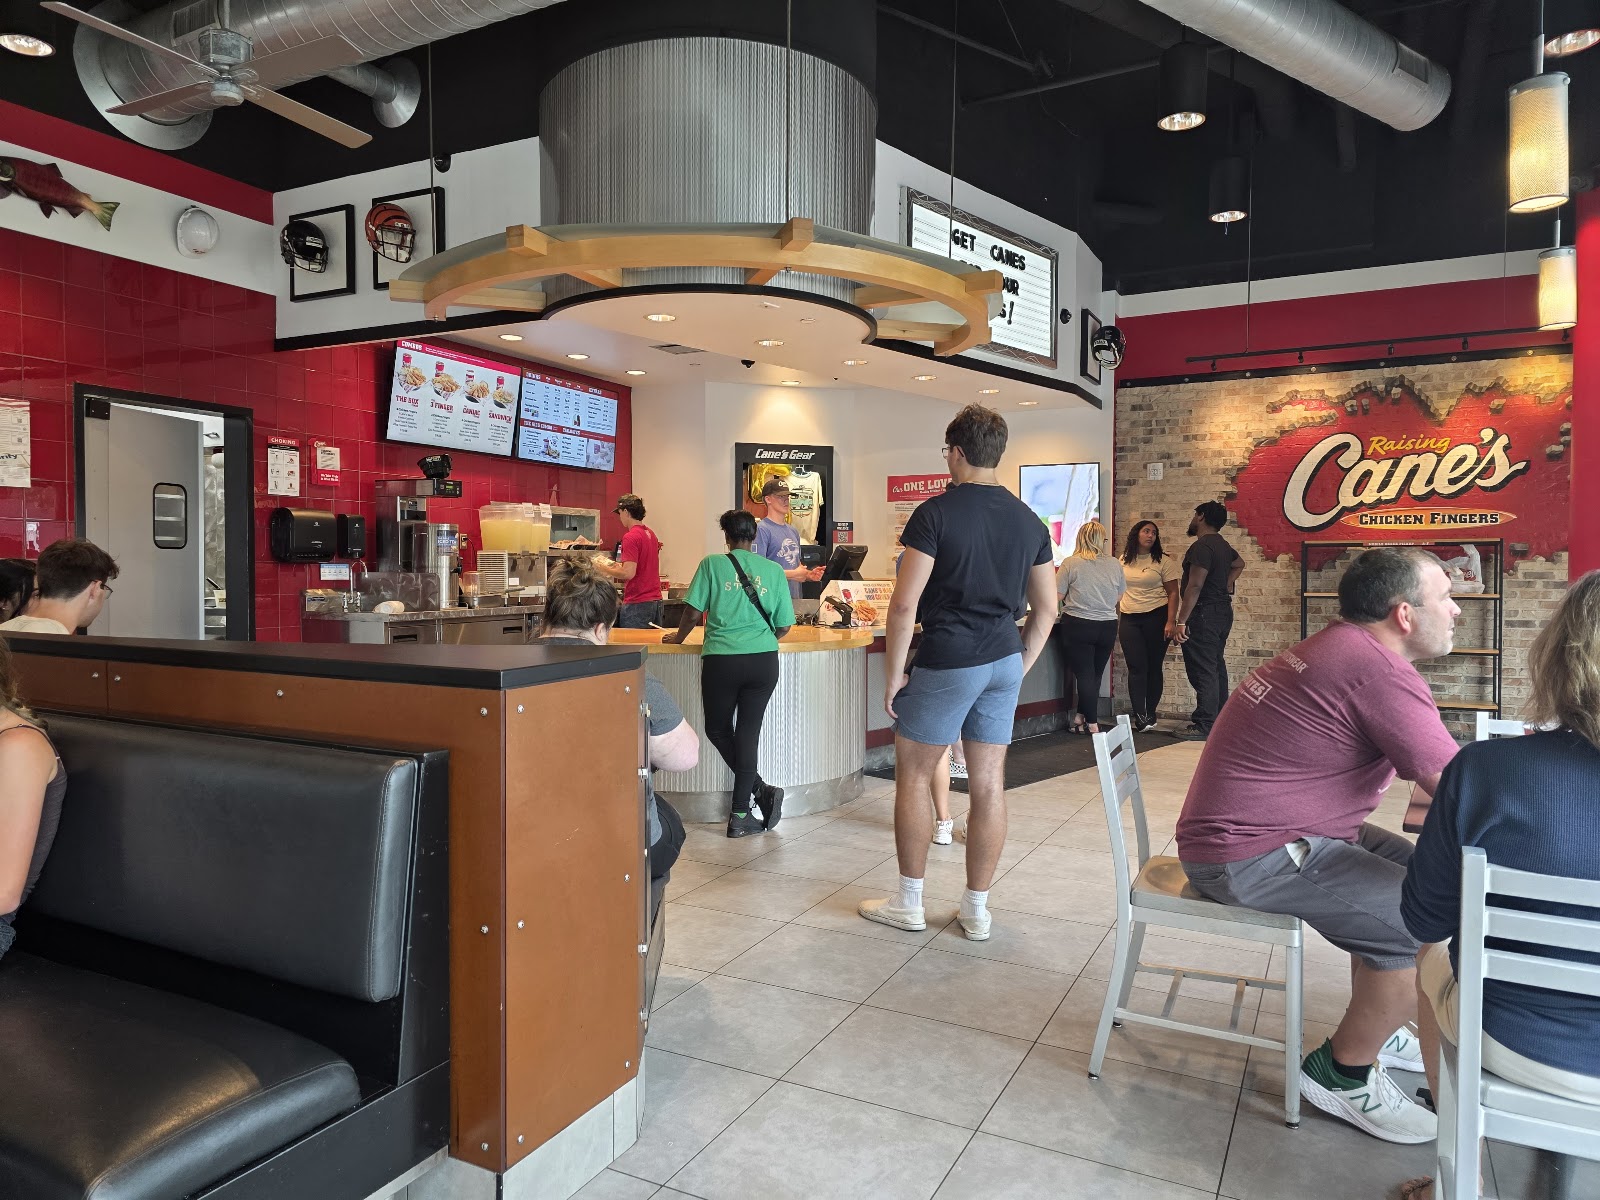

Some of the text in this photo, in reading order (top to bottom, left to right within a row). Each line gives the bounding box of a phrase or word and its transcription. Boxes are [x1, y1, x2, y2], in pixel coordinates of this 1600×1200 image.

[951, 229, 976, 251] GET
[990, 245, 1025, 271] CANES
[270, 437, 296, 446] CHOKING
[1367, 433, 1452, 456] Raising
[755, 448, 816, 461] Cane's Gear
[903, 481, 925, 492] ONE
[1283, 427, 1531, 533] Cane's
[1358, 511, 1500, 526] CHICKEN FINGERS
[1385, 1035, 1409, 1052] N
[1349, 1092, 1382, 1113] N
